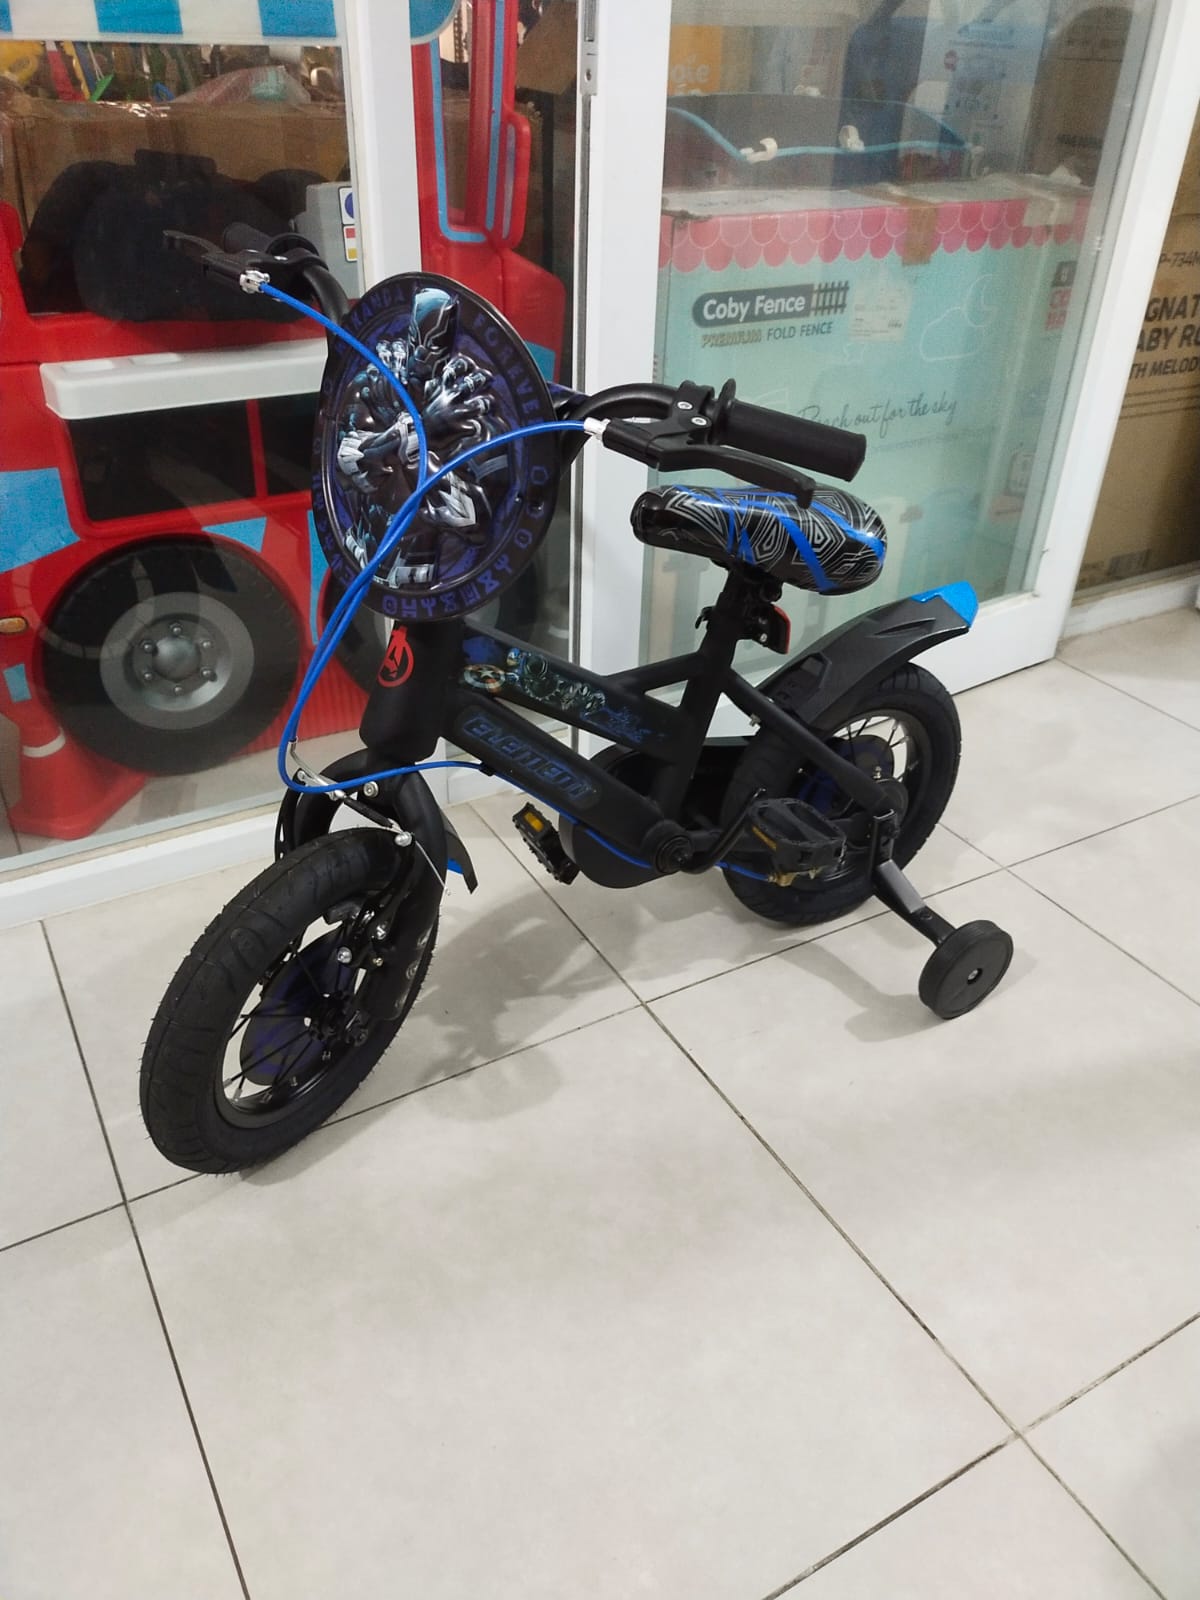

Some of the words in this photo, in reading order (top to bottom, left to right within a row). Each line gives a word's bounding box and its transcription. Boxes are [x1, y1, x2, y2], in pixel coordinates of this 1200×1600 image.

[703, 296, 750, 322] Coby
[754, 295, 806, 317] Fence
[766, 327, 797, 341] FOLD
[800, 321, 834, 337] FENCE
[1149, 355, 1200, 377] MELOD
[854, 406, 881, 426] out
[879, 400, 905, 439] for
[907, 392, 931, 417] the
[932, 391, 958, 426] sky
